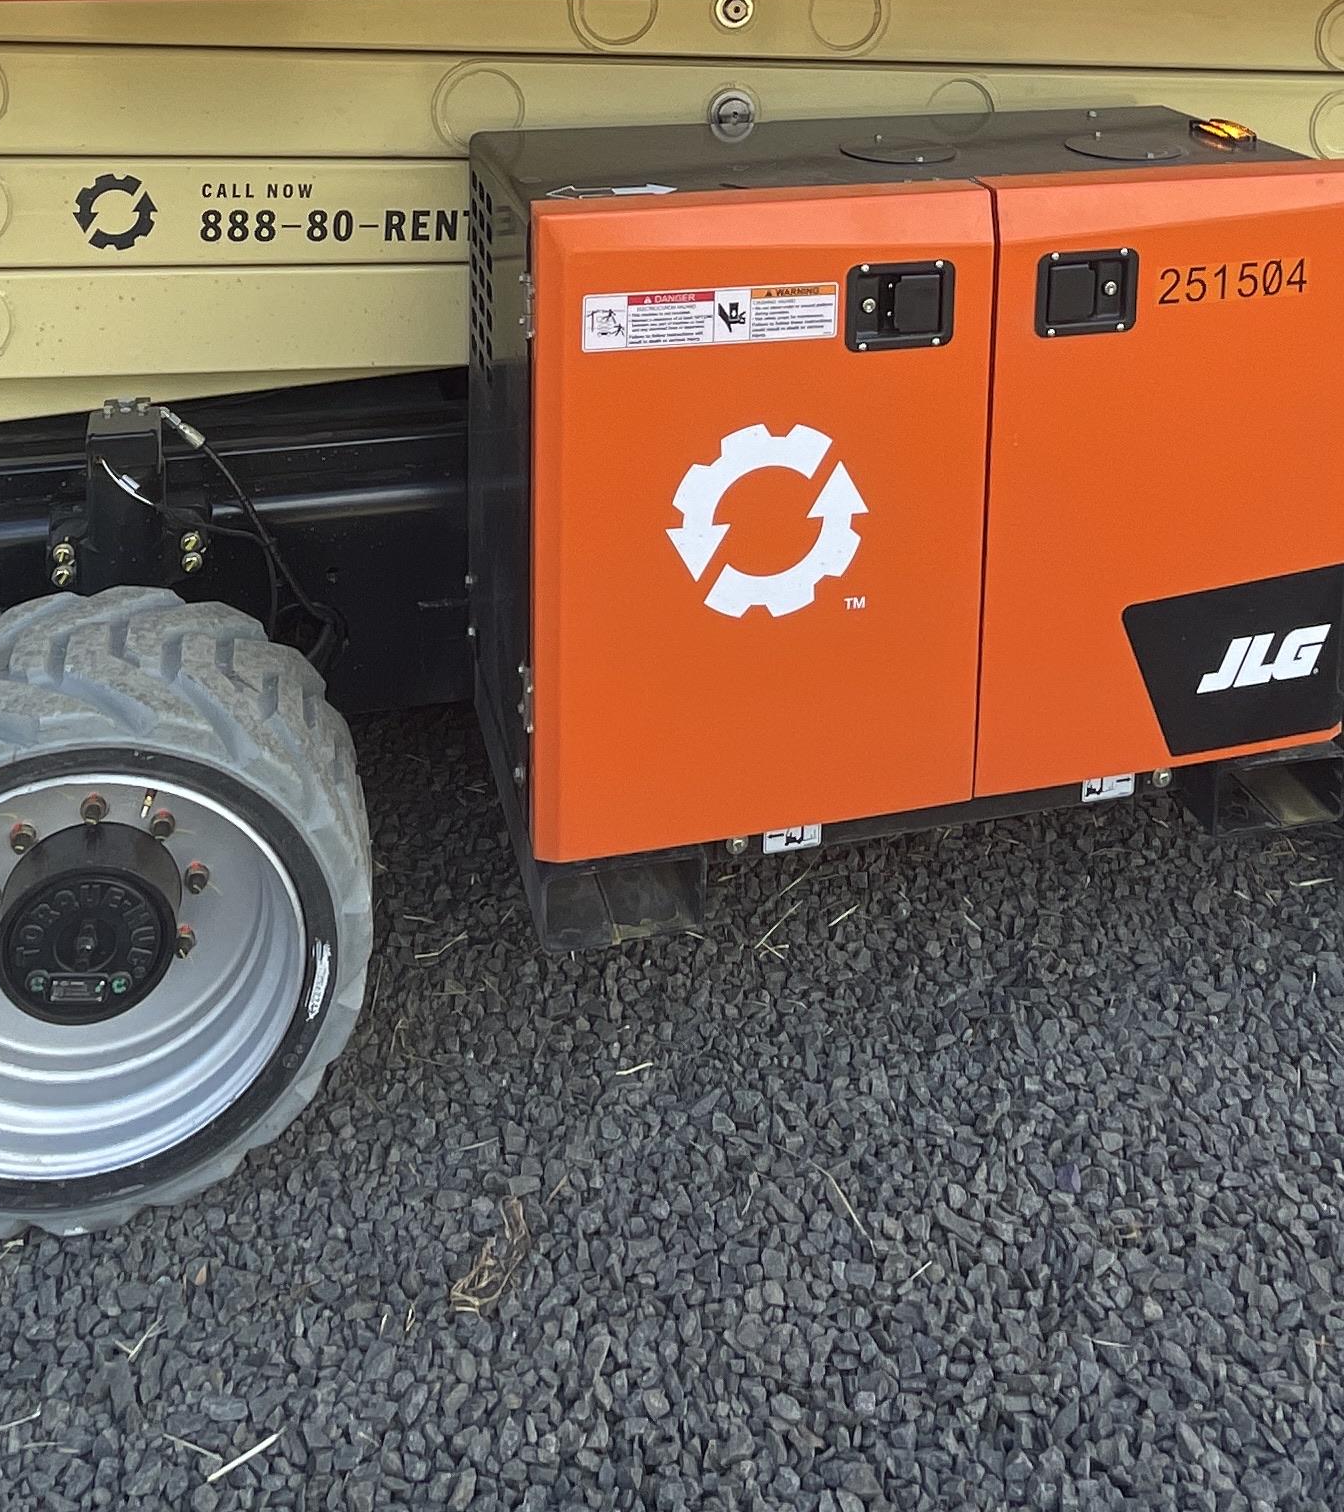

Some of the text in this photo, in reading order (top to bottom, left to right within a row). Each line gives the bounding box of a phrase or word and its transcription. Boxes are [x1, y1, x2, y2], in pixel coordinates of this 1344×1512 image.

[201, 183, 313, 199] CALL NOW
[1158, 258, 1308, 305] 251504
[654, 293, 697, 304] DANGER
[1196, 623, 1332, 694] JLG
